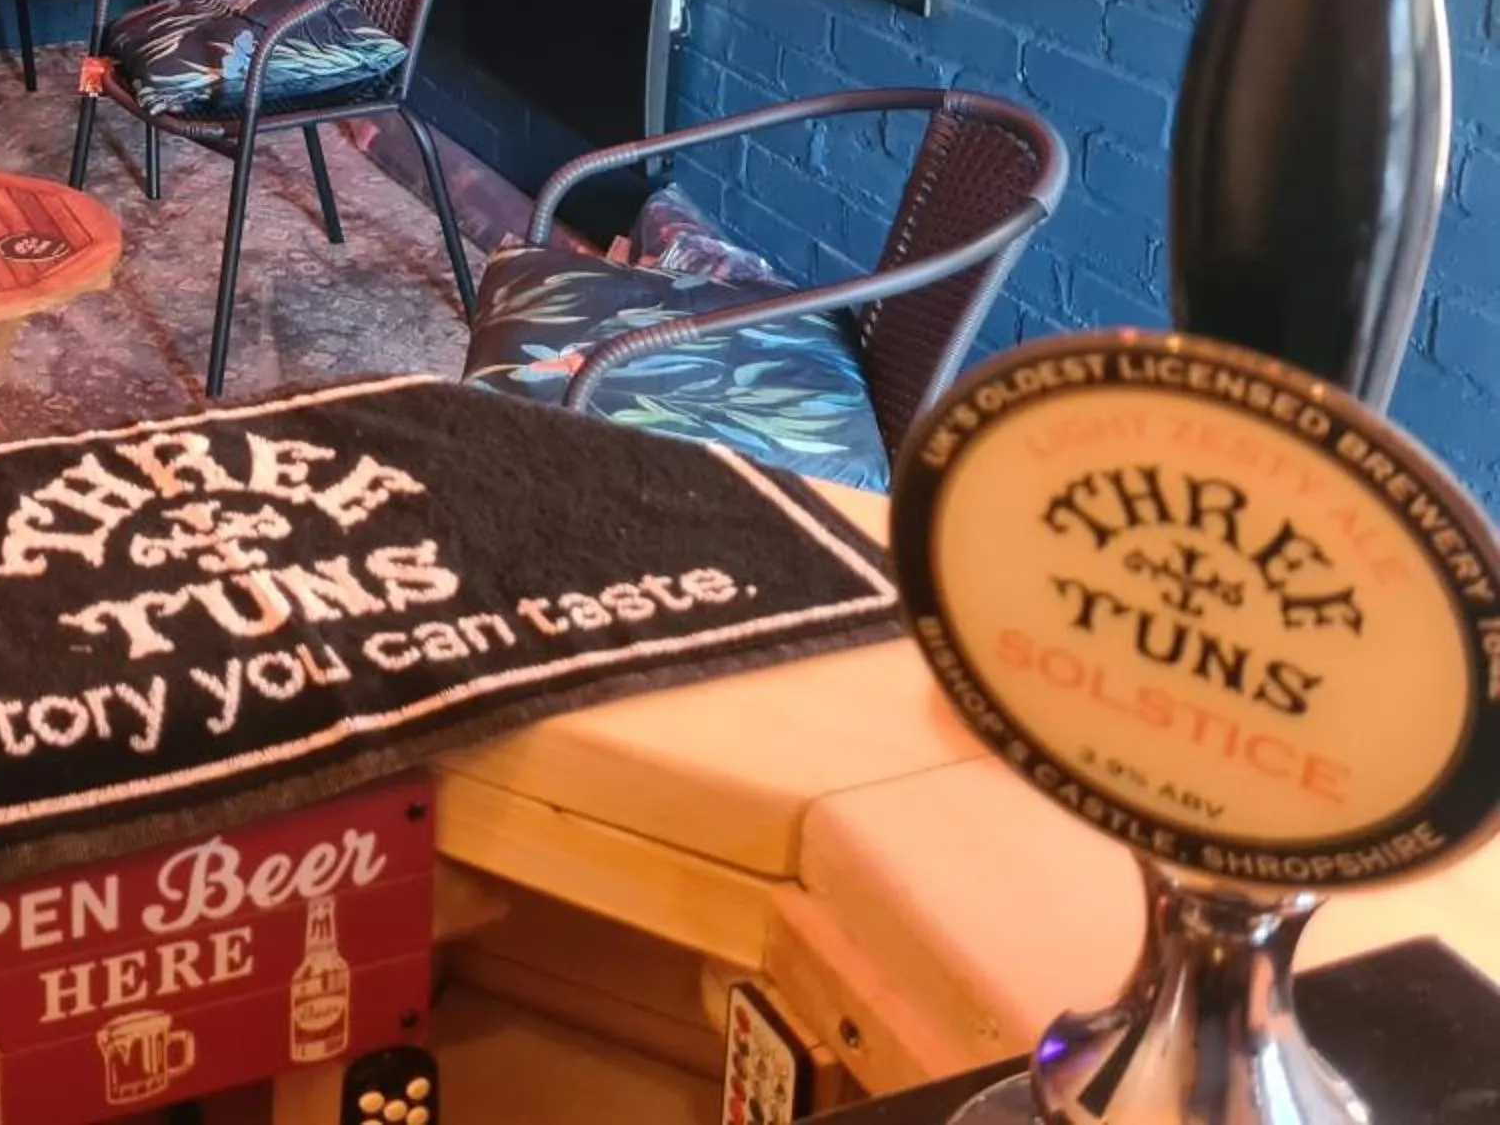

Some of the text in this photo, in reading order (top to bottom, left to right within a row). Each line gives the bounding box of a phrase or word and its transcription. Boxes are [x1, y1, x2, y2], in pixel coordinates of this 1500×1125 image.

[920, 403, 980, 468] UK'S
[975, 354, 1104, 411] OLDEST
[1118, 354, 1331, 437] LICENSED
[1336, 430, 1494, 603] BREWERY
[1039, 463, 1365, 637] THREE
[58, 539, 461, 661] TUNS
[189, 642, 353, 735] you
[362, 611, 517, 672] can
[516, 567, 758, 638] taste.
[1047, 574, 1324, 717] TUNS
[916, 615, 1031, 764] BISHOP'S
[1201, 820, 1446, 880] SHROPSHIRE
[995, 628, 1353, 806] SOLSTICE
[1157, 780, 1227, 819] ABV
[141, 827, 388, 934] Beer
[38, 925, 255, 1025] HERE
